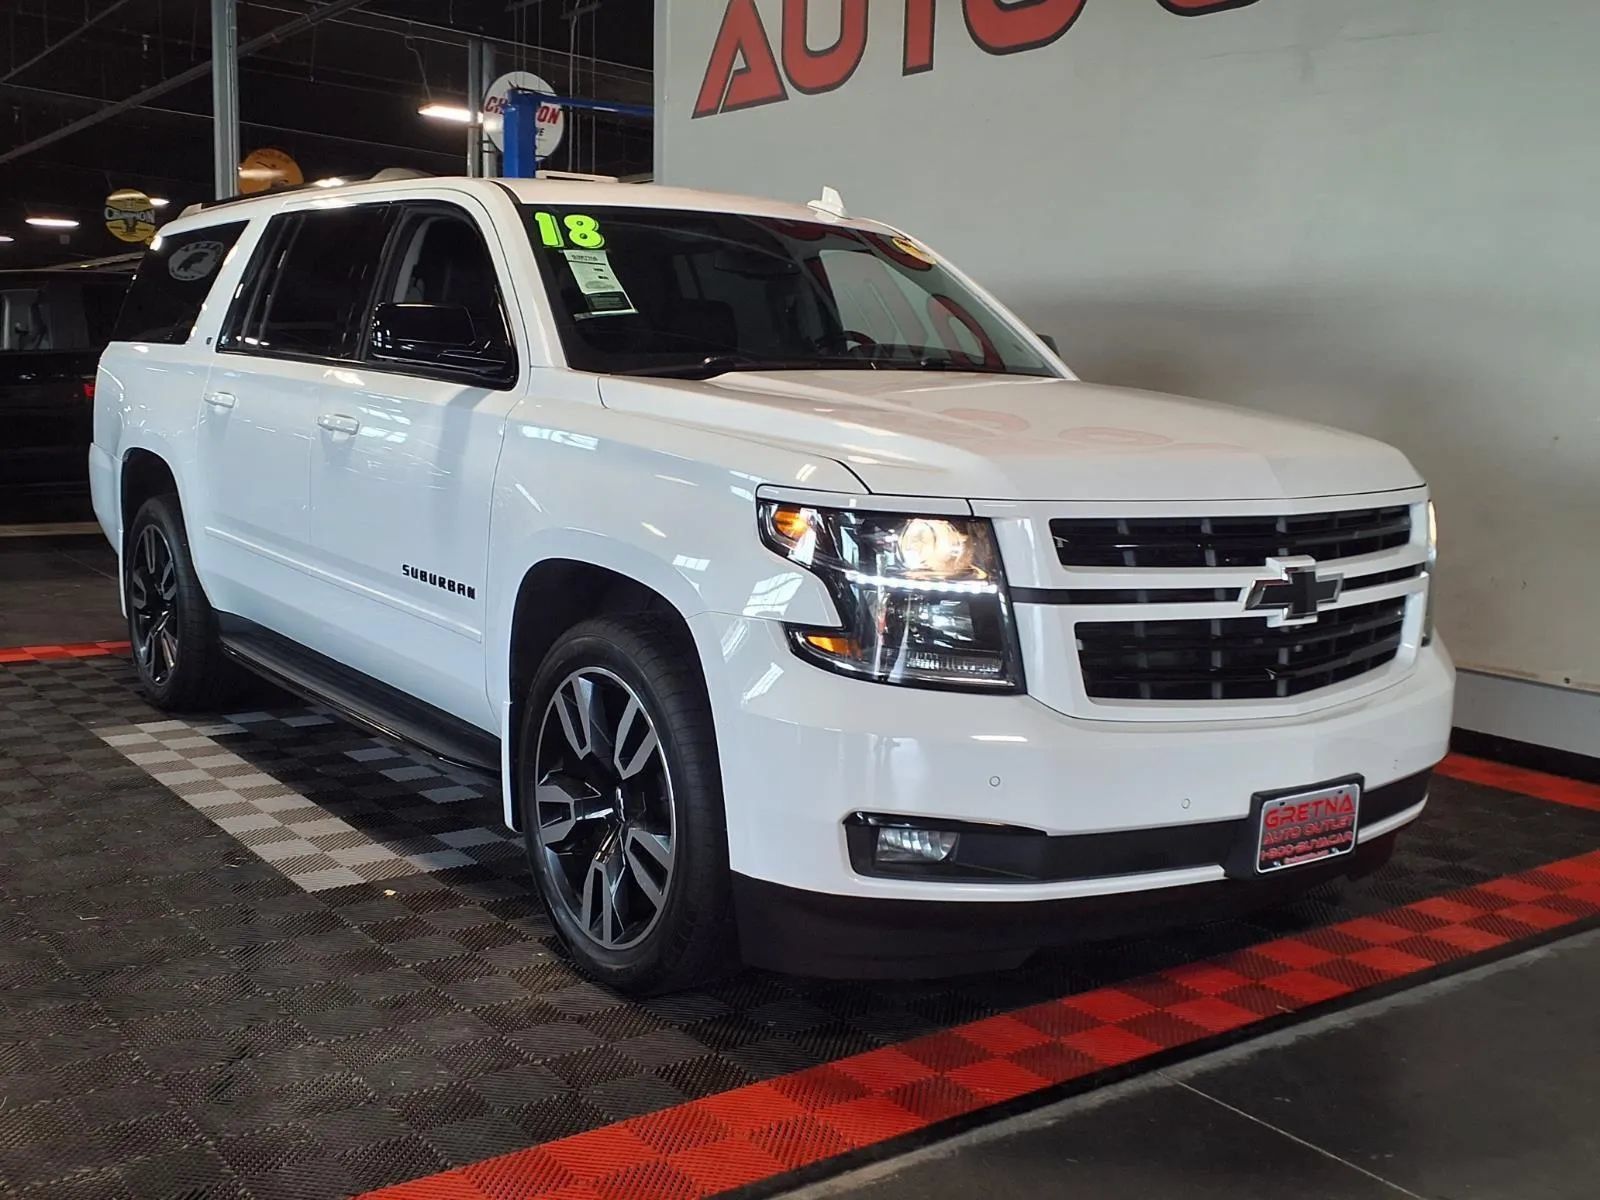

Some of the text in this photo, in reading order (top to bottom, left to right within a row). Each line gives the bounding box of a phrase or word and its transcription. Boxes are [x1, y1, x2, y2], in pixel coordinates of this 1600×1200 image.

[485, 95, 561, 125] CHON
[534, 211, 606, 249] 18
[402, 563, 476, 600] SUBURBAN
[1264, 793, 1354, 829] GRETNA
[1263, 825, 1301, 845] AUTO
